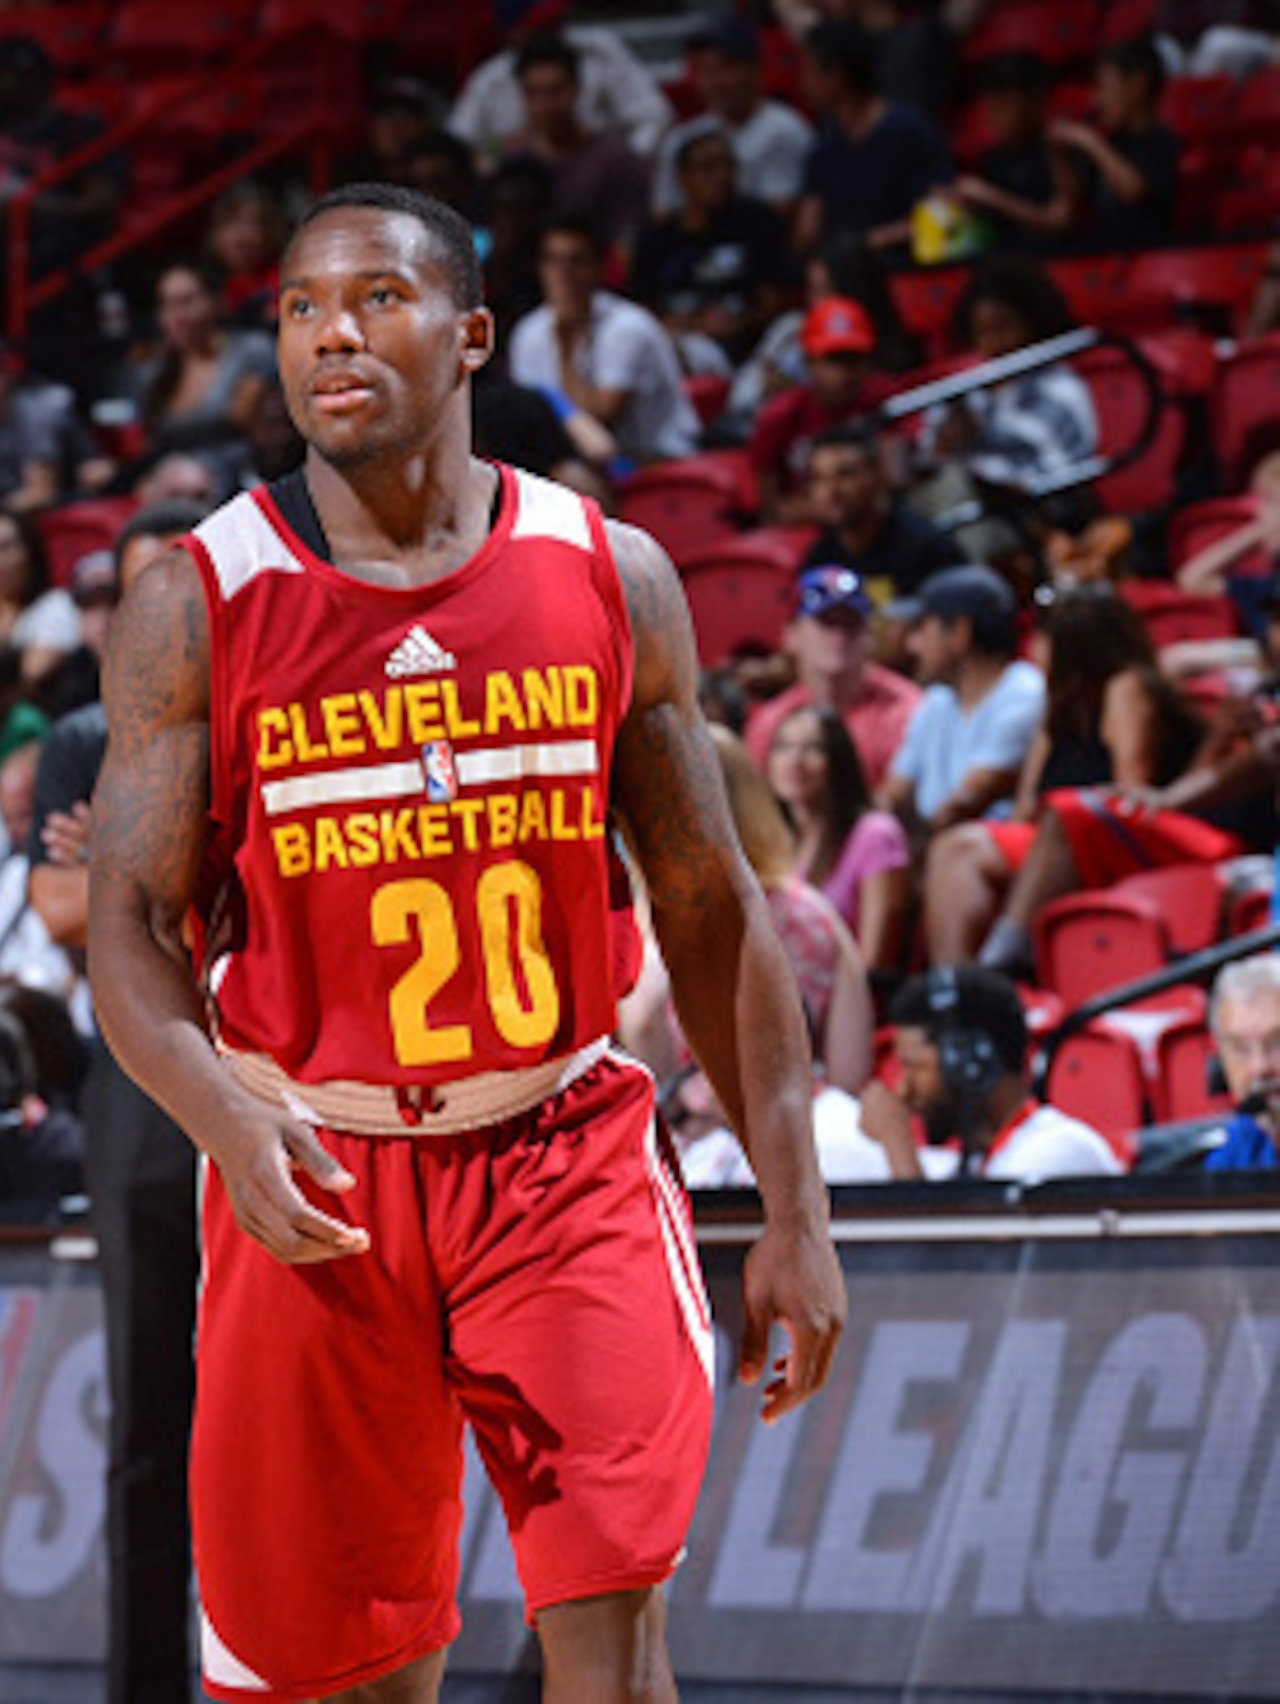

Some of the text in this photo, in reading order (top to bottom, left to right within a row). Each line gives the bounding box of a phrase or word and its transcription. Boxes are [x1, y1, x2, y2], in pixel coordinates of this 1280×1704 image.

[258, 665, 597, 769] CLEVELAND
[272, 786, 605, 877] BASKETBALL
[370, 859, 560, 1067] 20
[707, 1311, 1280, 1622] LEAGU
